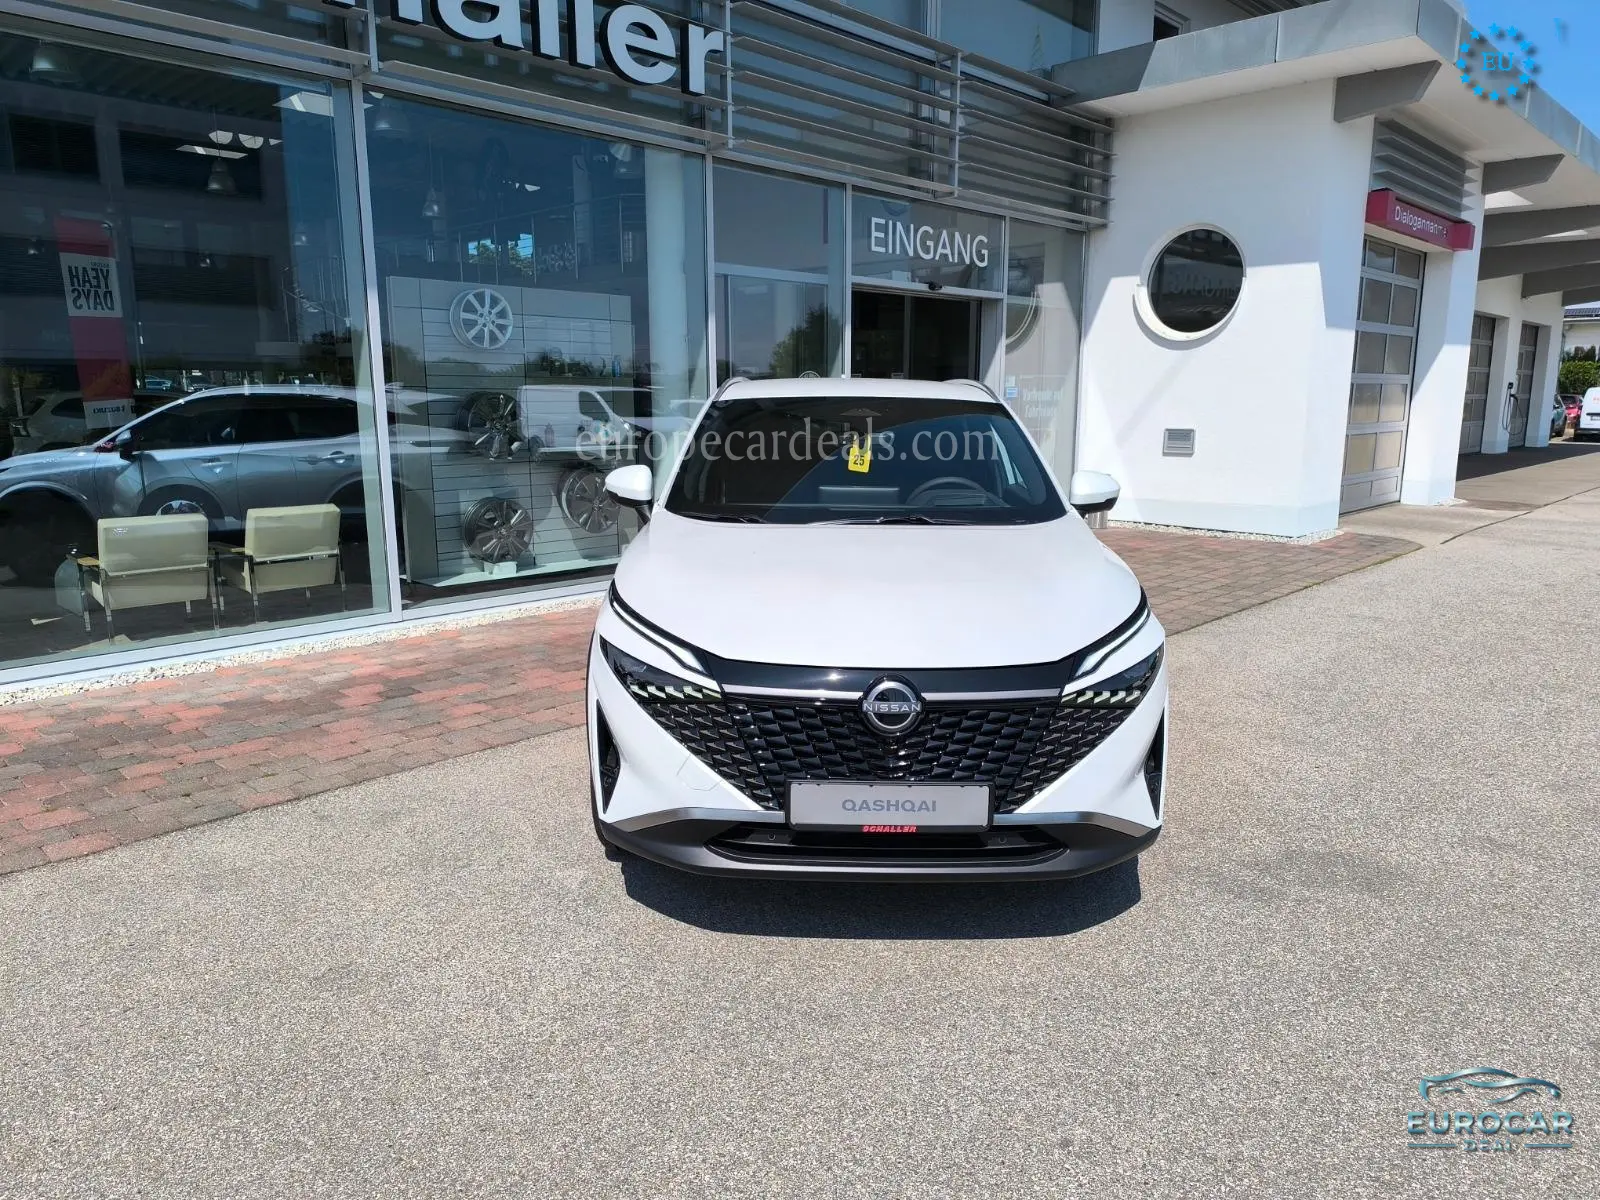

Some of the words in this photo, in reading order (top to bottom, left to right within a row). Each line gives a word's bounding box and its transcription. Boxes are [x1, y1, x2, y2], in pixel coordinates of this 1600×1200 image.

[334, 0, 724, 95] aller
[871, 216, 989, 268] EINGANG
[853, 454, 865, 466] 25
[863, 703, 920, 712] NISSAN
[841, 799, 937, 813] QASHQAI
[862, 825, 917, 833] SCHALLER
